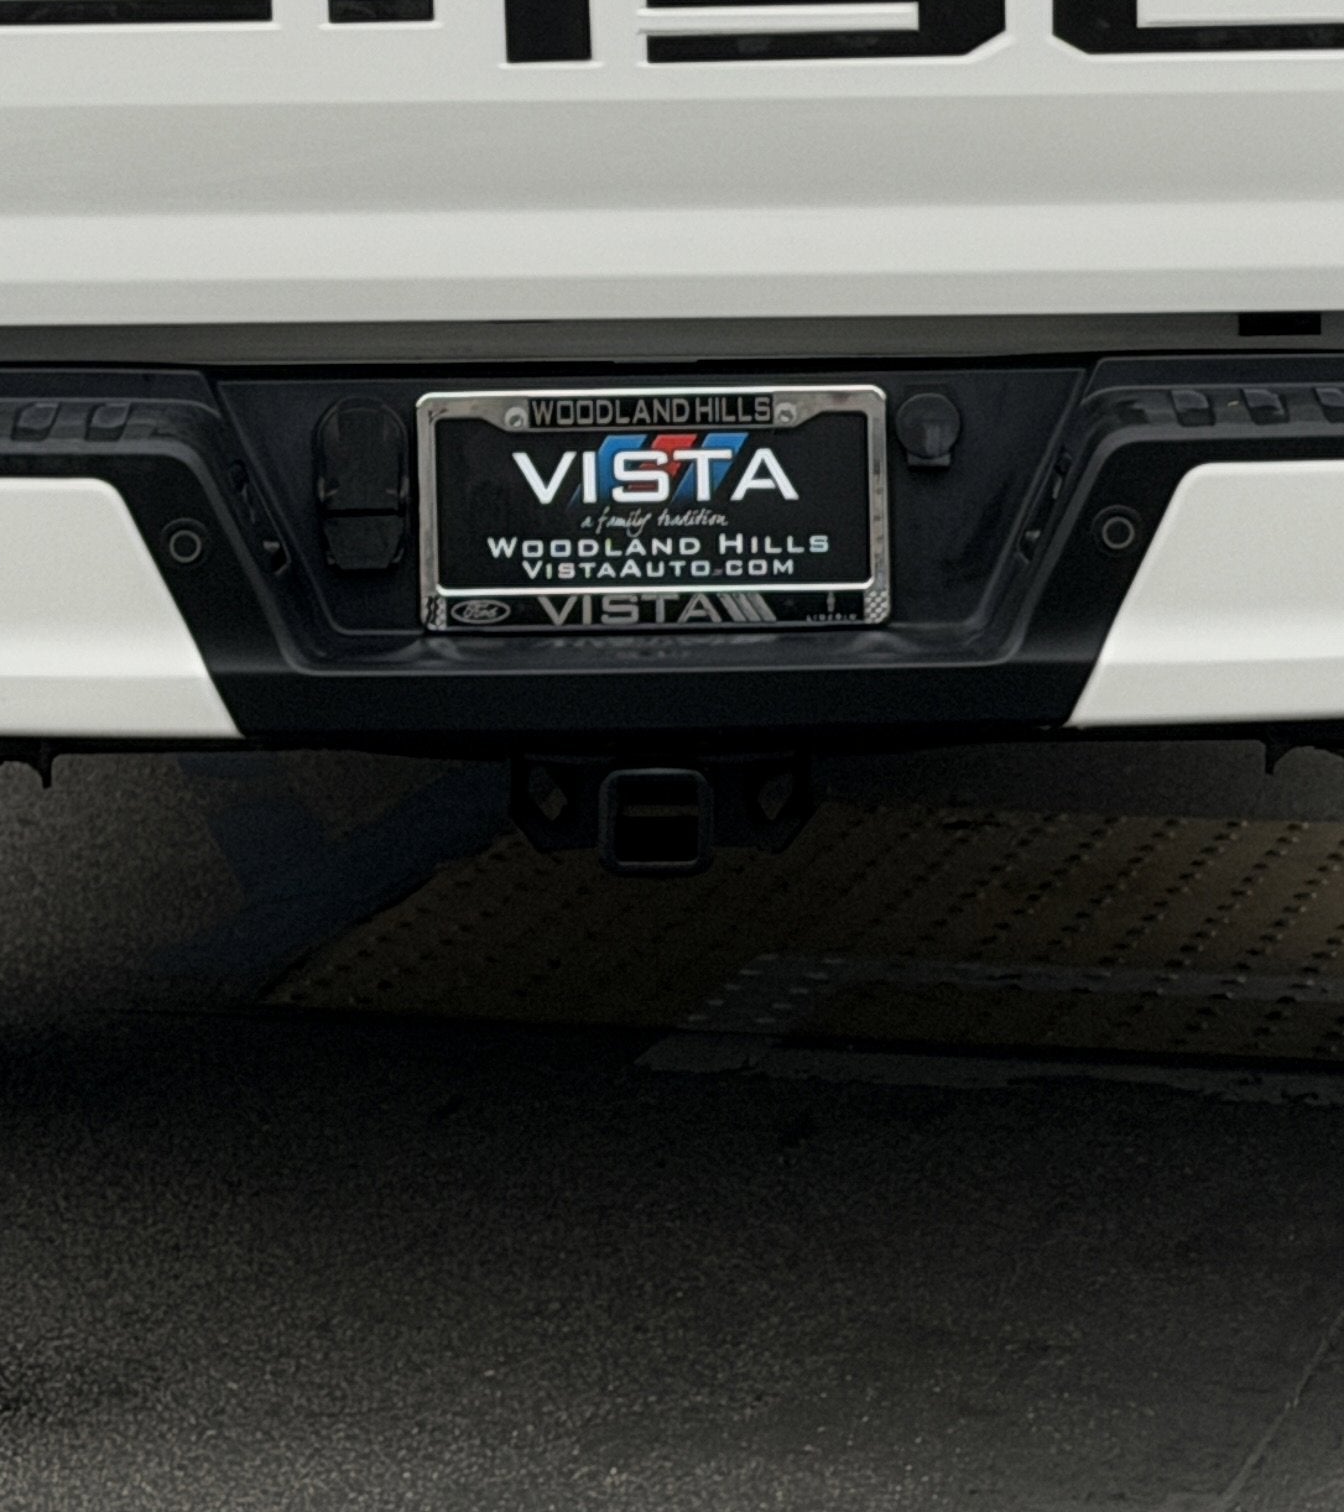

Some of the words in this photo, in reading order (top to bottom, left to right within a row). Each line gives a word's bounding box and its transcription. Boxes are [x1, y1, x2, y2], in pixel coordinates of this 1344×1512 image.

[531, 397, 690, 426] WOODLAND
[694, 396, 772, 424] HILLS
[511, 447, 800, 504] VISTA
[580, 515, 593, 529] a
[594, 505, 653, 538] family
[657, 507, 729, 527] tradition
[487, 535, 702, 559] WOODLAND
[718, 532, 830, 555] HILLS
[536, 591, 723, 626] VISTA
